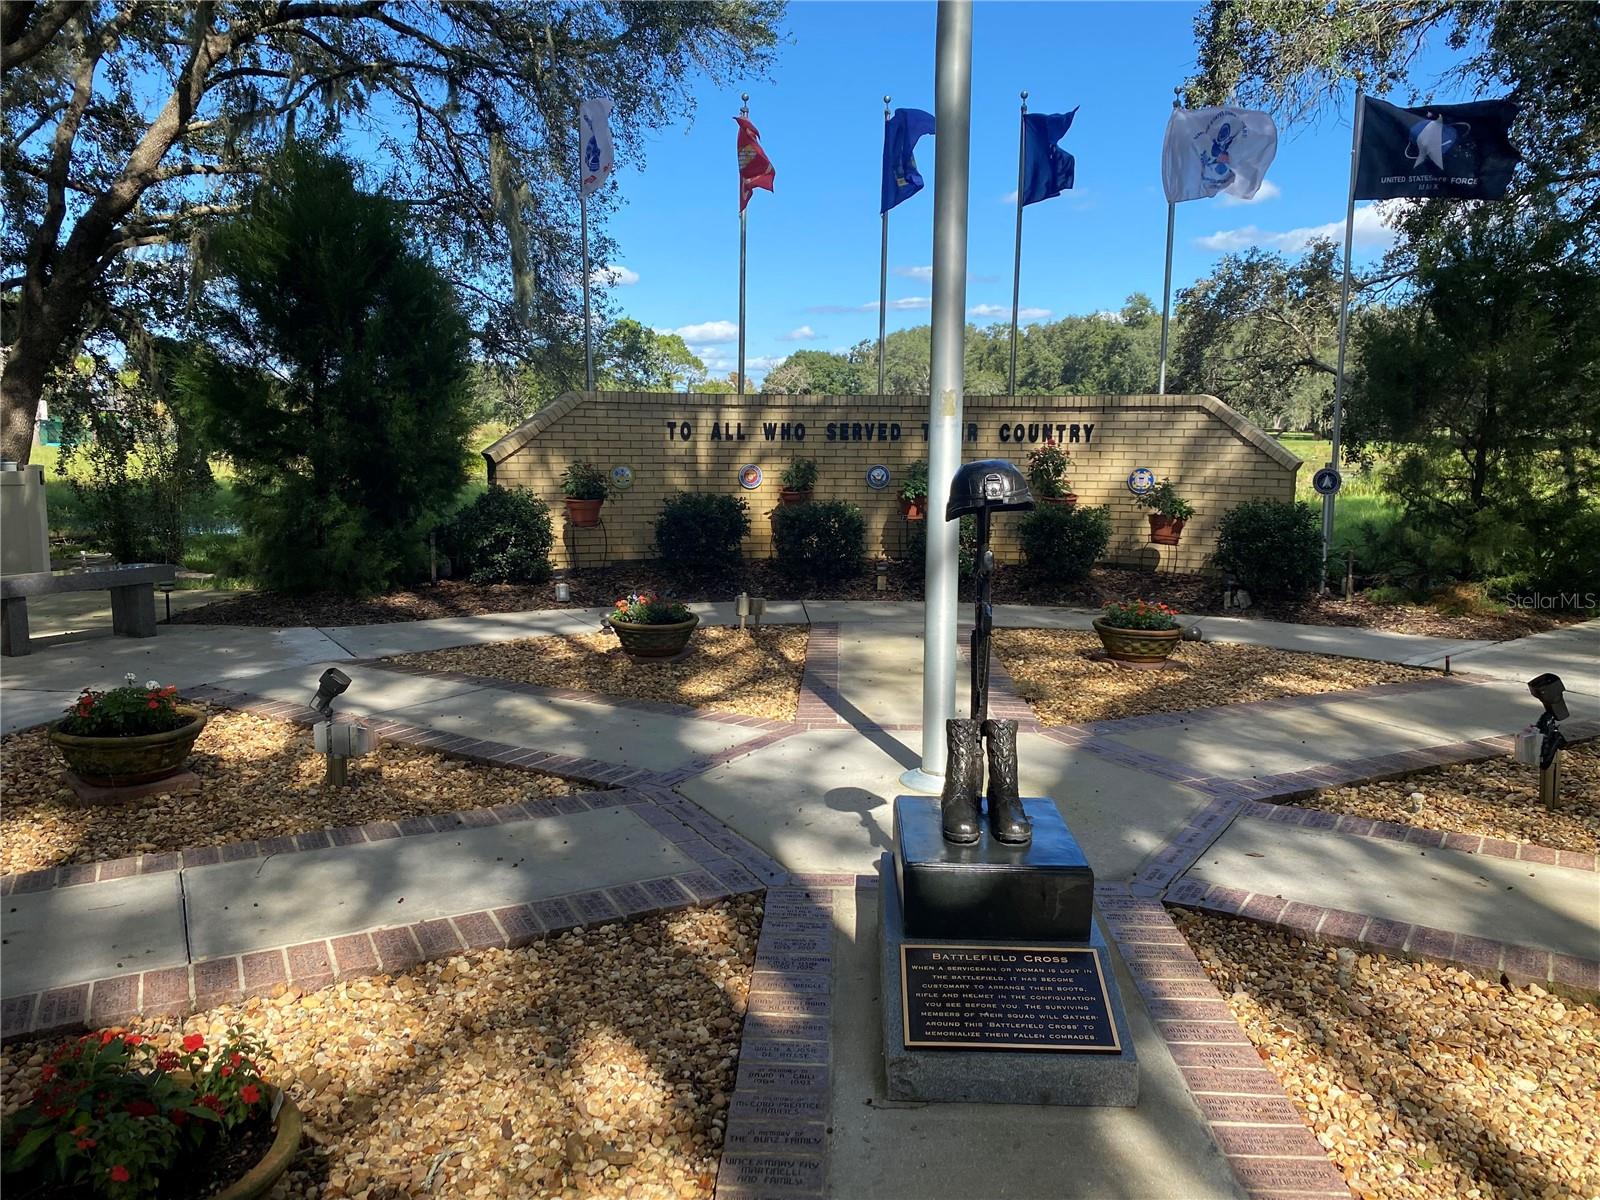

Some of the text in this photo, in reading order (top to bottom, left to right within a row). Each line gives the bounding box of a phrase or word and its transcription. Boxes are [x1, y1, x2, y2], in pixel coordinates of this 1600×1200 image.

[1380, 176, 1406, 184] UNITED
[1450, 177, 1478, 185] FORCE
[667, 421, 691, 441] TO
[711, 422, 746, 441] ALL
[763, 422, 806, 441] WHO
[826, 422, 901, 441] SERVED
[999, 423, 1096, 443] COUNTRY
[932, 952, 1069, 963] BATTLEFIELD CROSS
